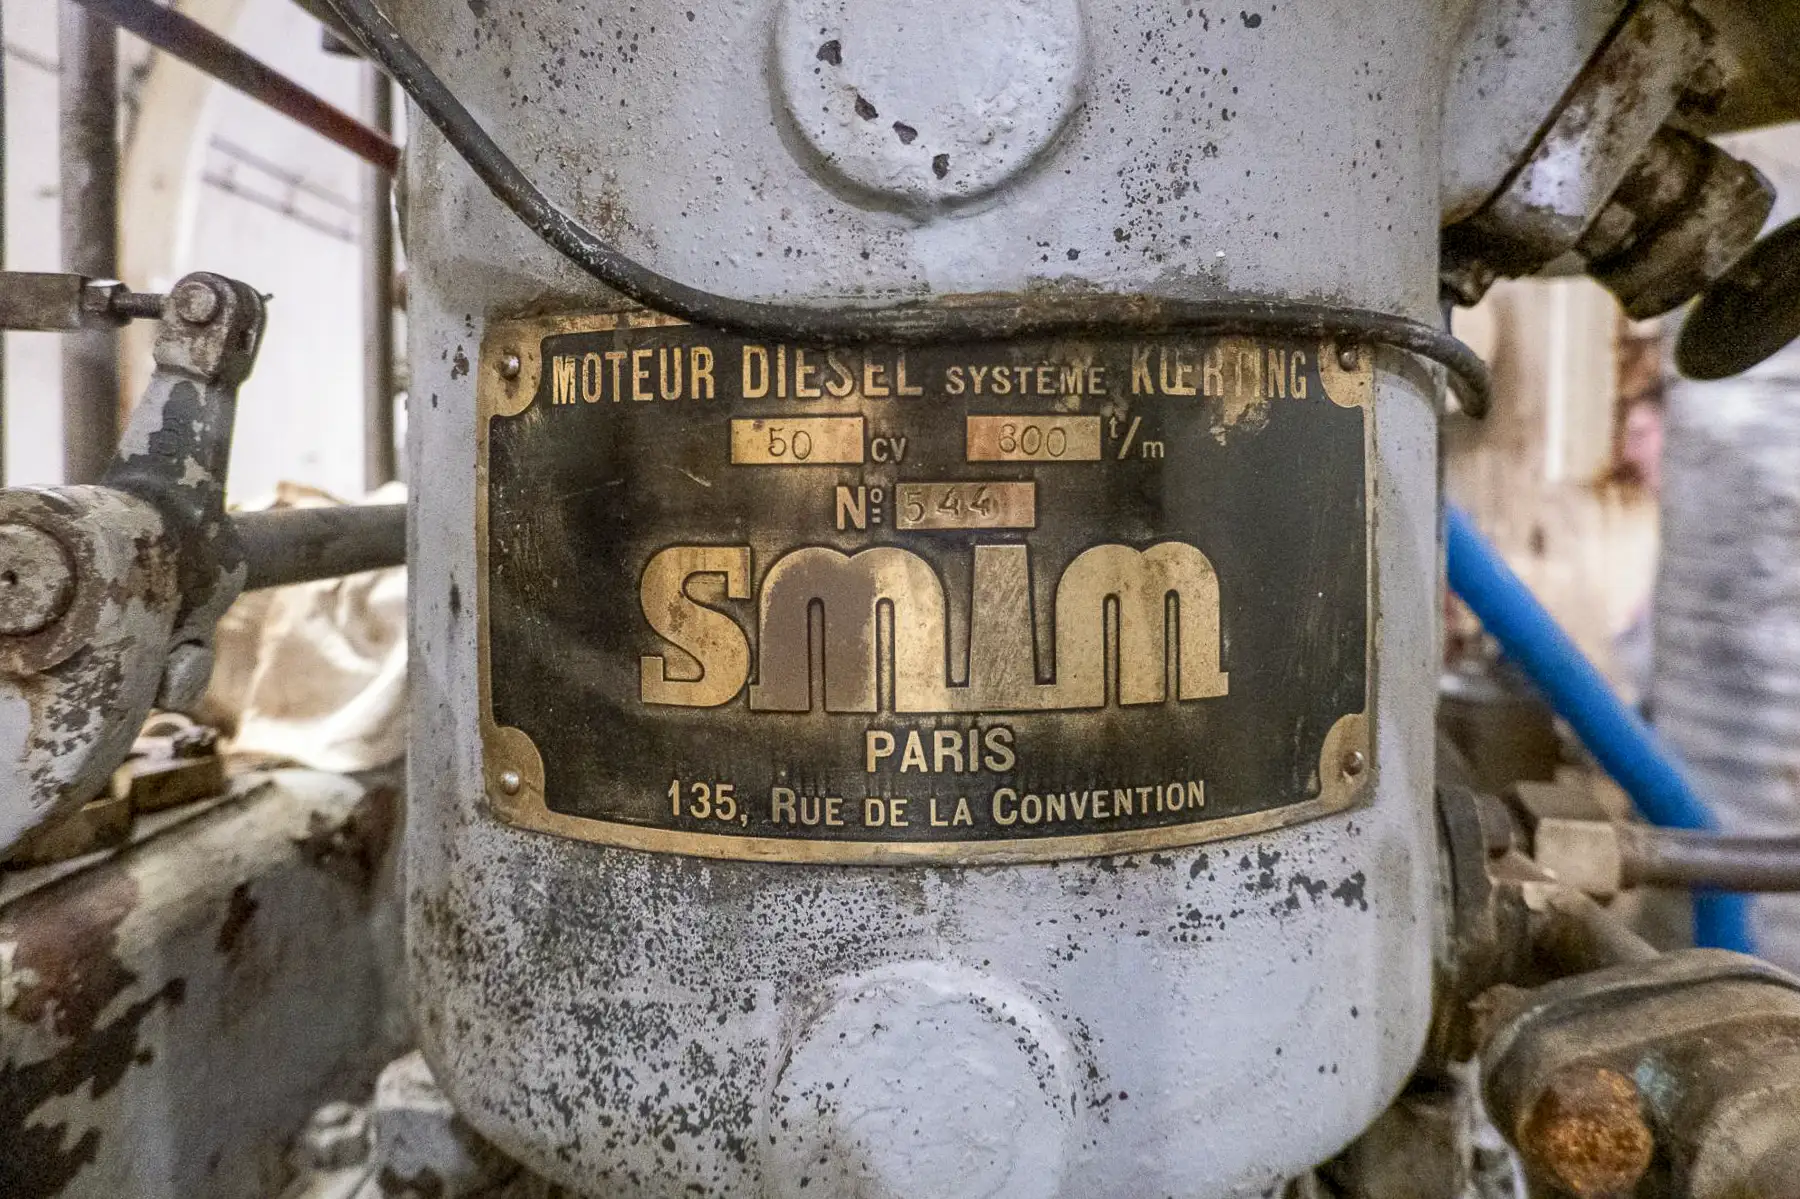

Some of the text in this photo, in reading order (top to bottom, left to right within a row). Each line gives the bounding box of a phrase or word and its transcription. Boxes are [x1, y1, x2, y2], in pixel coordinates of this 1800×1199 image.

[551, 345, 715, 405] MOTEUR
[742, 344, 923, 398] DIESEL
[768, 427, 812, 461] 50
[903, 484, 988, 523] 544
[865, 727, 1016, 773] PARIS
[667, 779, 1206, 828] 135, RUE DE LA CONVENTION
